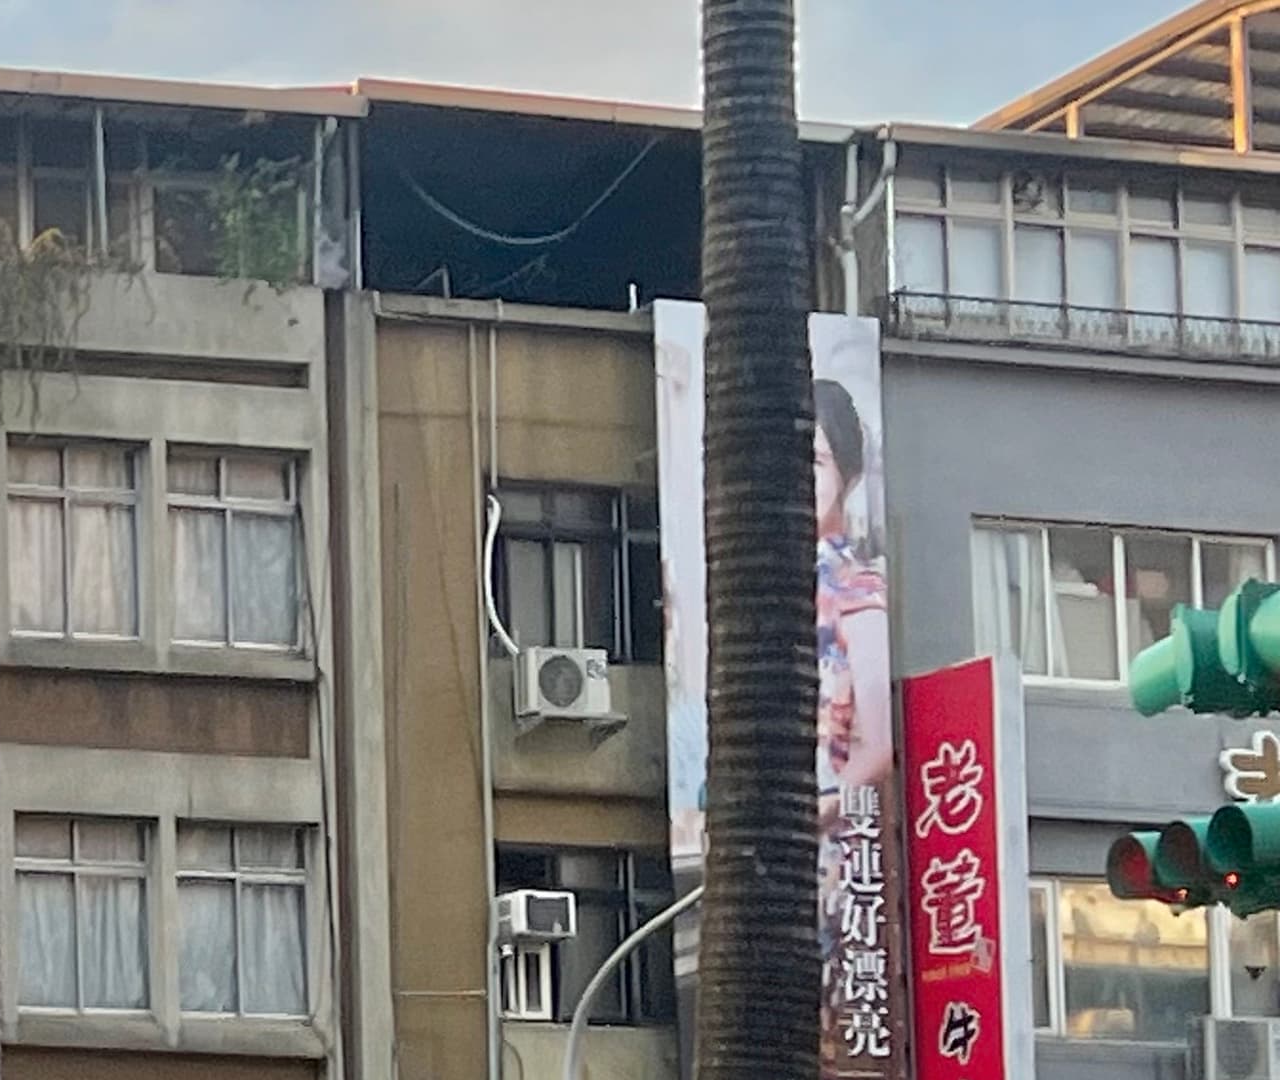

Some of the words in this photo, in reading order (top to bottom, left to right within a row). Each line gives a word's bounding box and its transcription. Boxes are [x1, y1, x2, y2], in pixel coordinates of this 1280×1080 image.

[839, 784, 892, 1058] 雙連好漂亮
[916, 739, 985, 954] 老董
